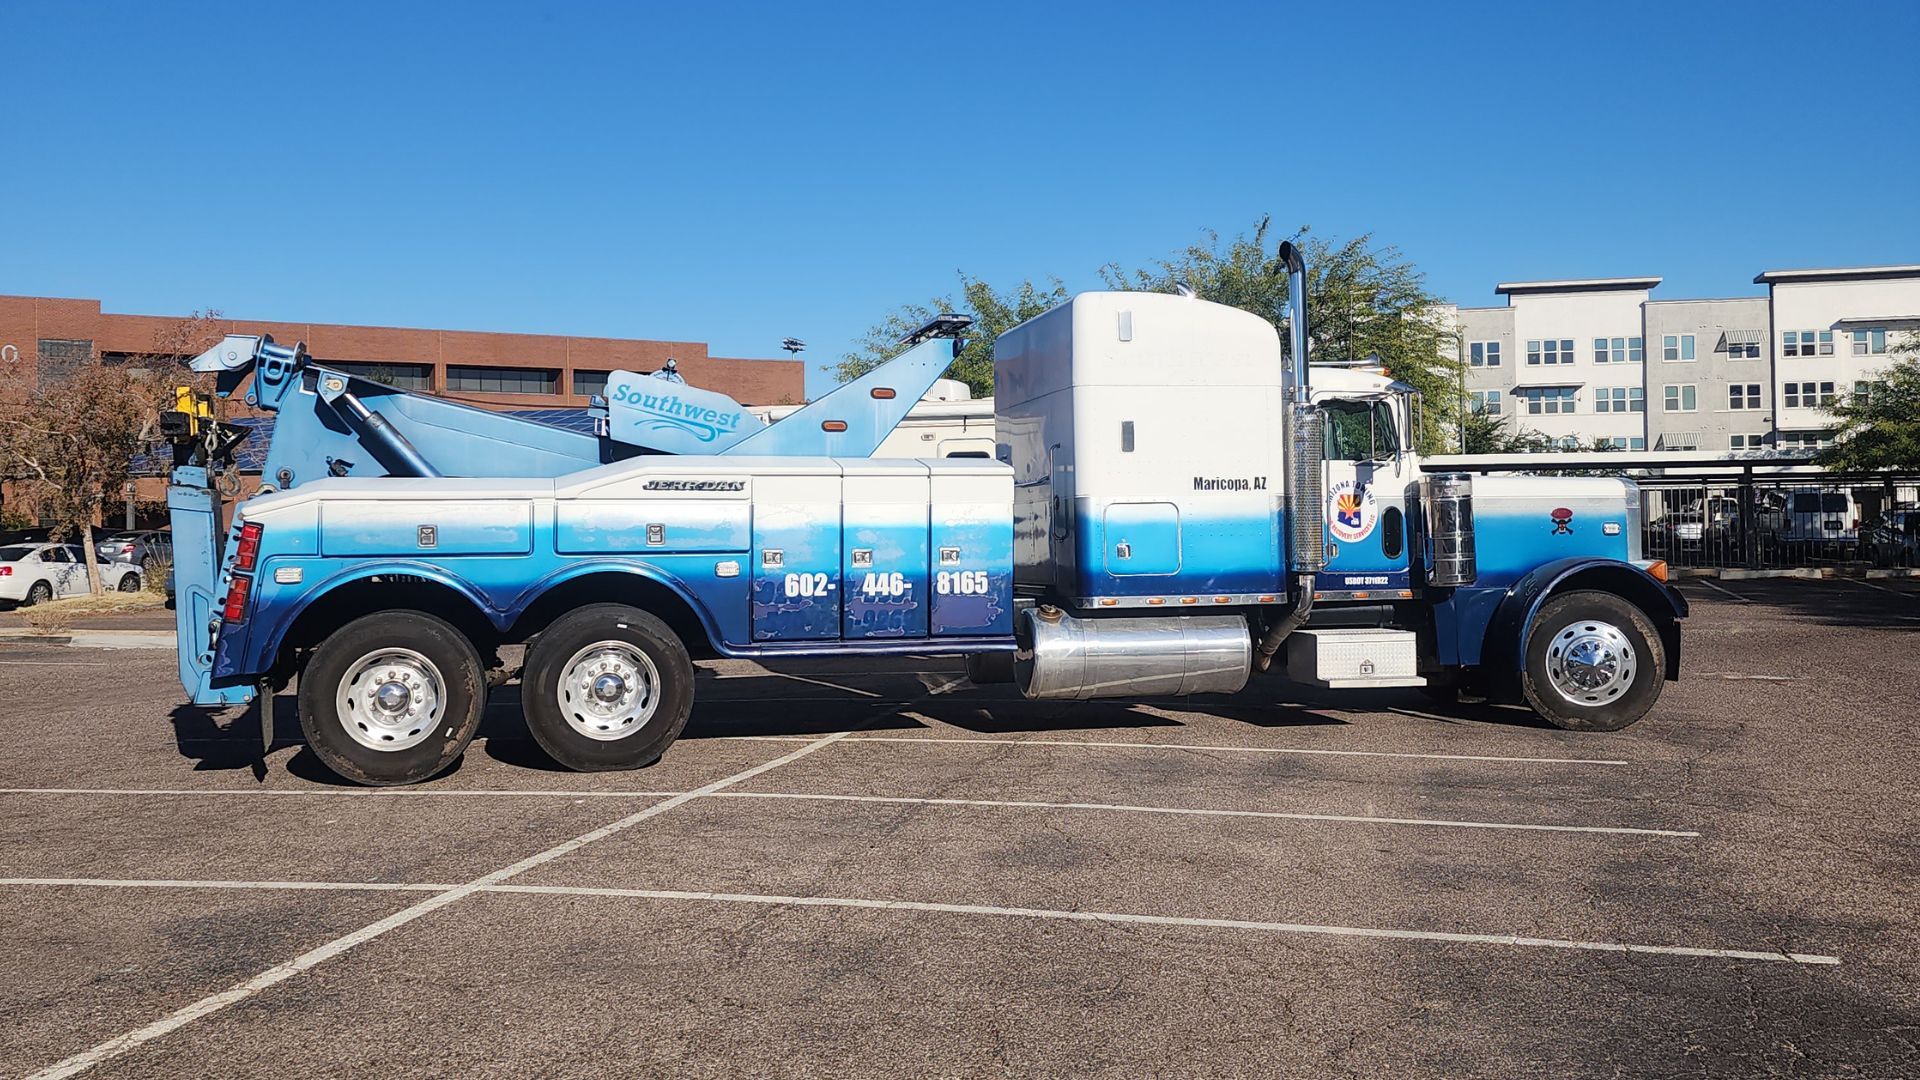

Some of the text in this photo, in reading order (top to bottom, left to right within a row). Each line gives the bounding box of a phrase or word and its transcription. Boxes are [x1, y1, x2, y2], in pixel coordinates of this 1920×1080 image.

[612, 384, 742, 428] Southwest
[642, 480, 746, 491] JERR-DAN
[1193, 476, 1267, 492] Maricopa, AZ
[1326, 480, 1376, 506] RIZONA TOWING
[784, 571, 989, 597] 602- 446- 8165
[1344, 576, 1365, 586] USDOT
